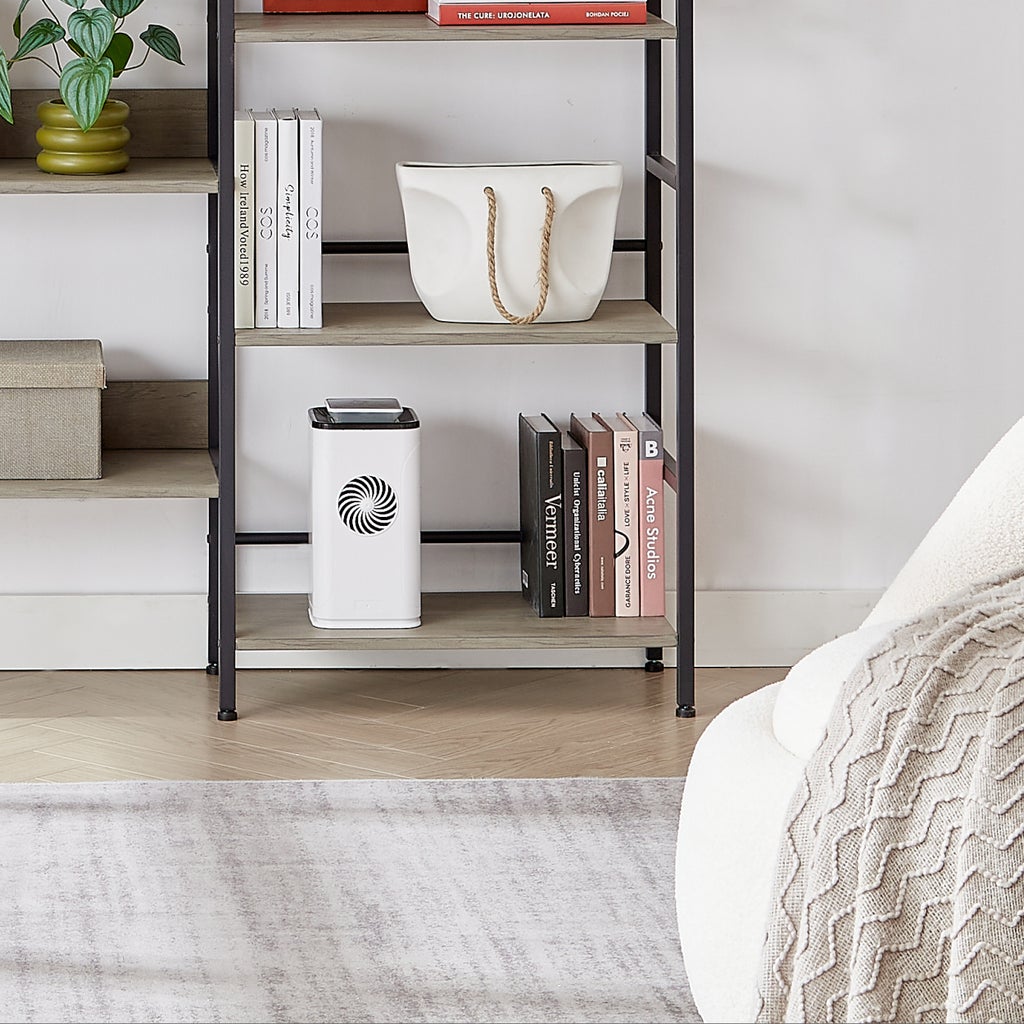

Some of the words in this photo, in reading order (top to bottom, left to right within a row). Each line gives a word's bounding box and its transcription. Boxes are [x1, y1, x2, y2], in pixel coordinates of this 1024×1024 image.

[473, 12, 495, 20] CURE:
[240, 164, 250, 188] How
[260, 206, 273, 240] COS
[282, 184, 294, 240] Simplicity
[306, 206, 319, 240] COS
[645, 440, 658, 458] B
[646, 487, 658, 523] Acne
[544, 494, 562, 570] Vermeer
[572, 500, 582, 551] Organizational
[646, 528, 660, 580] Studios
[572, 554, 582, 594] Cybernetics
